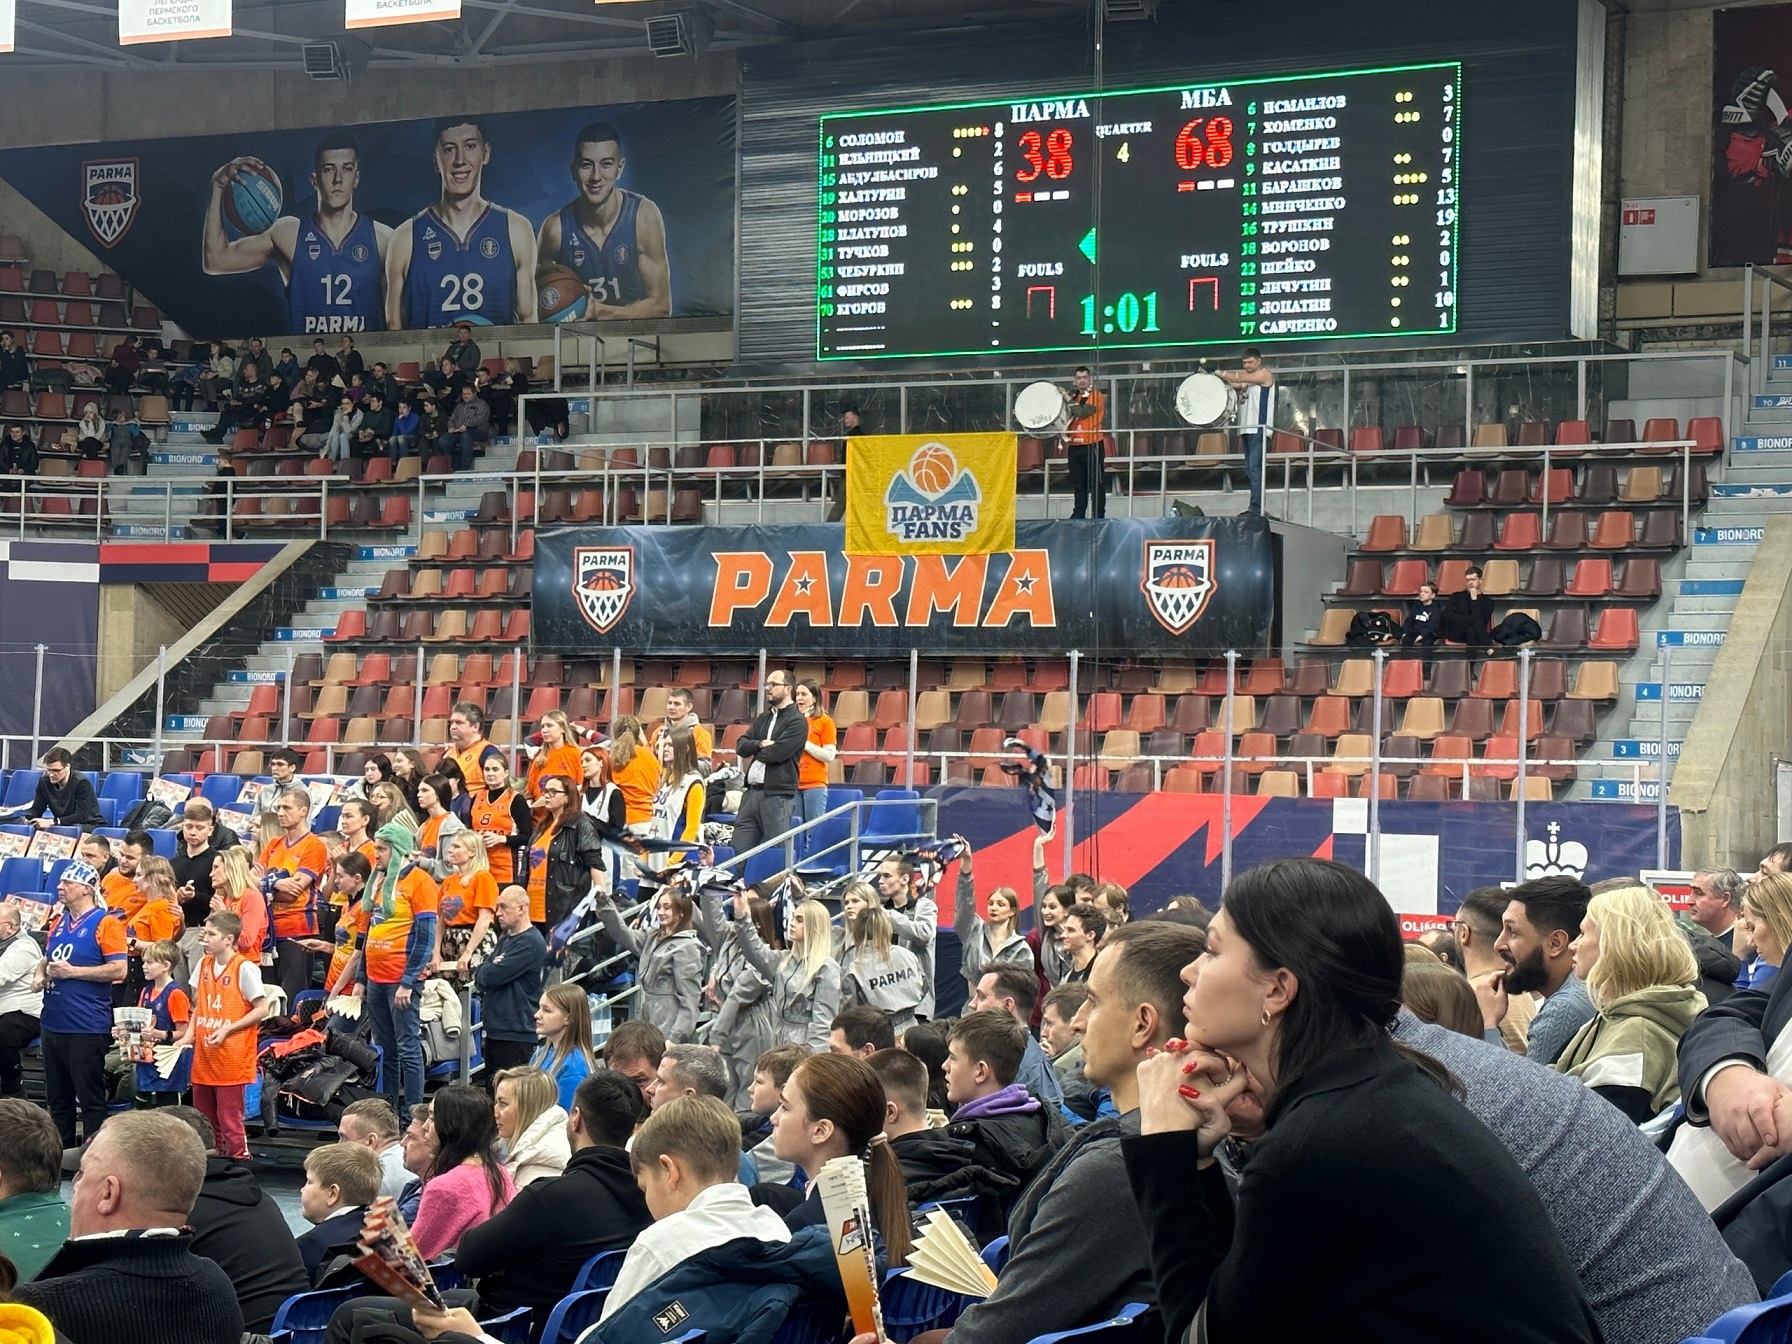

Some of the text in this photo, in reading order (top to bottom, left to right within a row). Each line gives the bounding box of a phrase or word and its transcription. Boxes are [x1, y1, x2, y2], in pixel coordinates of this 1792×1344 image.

[149, 5, 199, 15] ПЕРМСКОГО
[147, 15, 201, 26] БАСКЕТБОЛА
[1180, 87, 1233, 109] МБА
[1443, 85, 1453, 102] 3
[1011, 99, 1090, 123] ПАРМА
[1263, 117, 1336, 133] ХОМЕНКО
[1443, 106, 1453, 122] 7
[994, 122, 1004, 138] 8
[1442, 127, 1453, 143] 0
[994, 141, 1003, 157] 2
[1175, 117, 1233, 170] 68
[1015, 128, 1073, 182] 38
[1116, 142, 1130, 163] 4
[1442, 148, 1452, 163] 7
[90, 166, 132, 180] PARMA
[993, 160, 1003, 175] 6
[1441, 168, 1452, 183] 5
[993, 180, 1003, 195] 5
[1437, 189, 1455, 205] 13
[838, 207, 899, 222] МОРОЗОВ
[993, 199, 1002, 214] 0
[1436, 209, 1454, 226] 19
[993, 219, 1002, 233] 4
[838, 245, 889, 259] ТУЧКОВ
[992, 237, 1002, 253] 0
[1261, 238, 1330, 254] ВОРОНОВ
[1440, 230, 1451, 246] 2
[992, 257, 1001, 272] 2
[1180, 253, 1229, 268] FOULS
[1440, 251, 1450, 266] 0
[1018, 262, 1064, 277] FOULS
[992, 276, 1001, 291] 3
[1440, 271, 1449, 286] 1
[321, 274, 352, 305] 12
[440, 273, 484, 312] 28
[589, 276, 621, 303] 31
[837, 302, 886, 315] ЕГОРОВ
[991, 295, 1001, 309] 8
[1435, 291, 1454, 308] 10
[1080, 291, 1160, 335] 1:01
[1259, 318, 1337, 334] САВЧЕНКО
[1439, 313, 1448, 328] 1
[168, 455, 202, 464] BIONORD
[892, 505, 973, 522] ПАРМА
[903, 522, 961, 539] FANS
[373, 548, 405, 556] BIONORD
[1153, 550, 1204, 560] PARMA
[582, 555, 626, 566] PARMA
[708, 549, 1057, 627] PARMA
[292, 630, 320, 638] BIONORD
[247, 673, 275, 681] BIONORD
[1642, 688, 1648, 696] 4
[1620, 746, 1626, 754] 3
[1599, 787, 1605, 795] 2
[480, 813, 491, 825] 8
[51, 943, 73, 961] 60
[869, 968, 916, 990] PARMA
[207, 994, 222, 1013] 14
